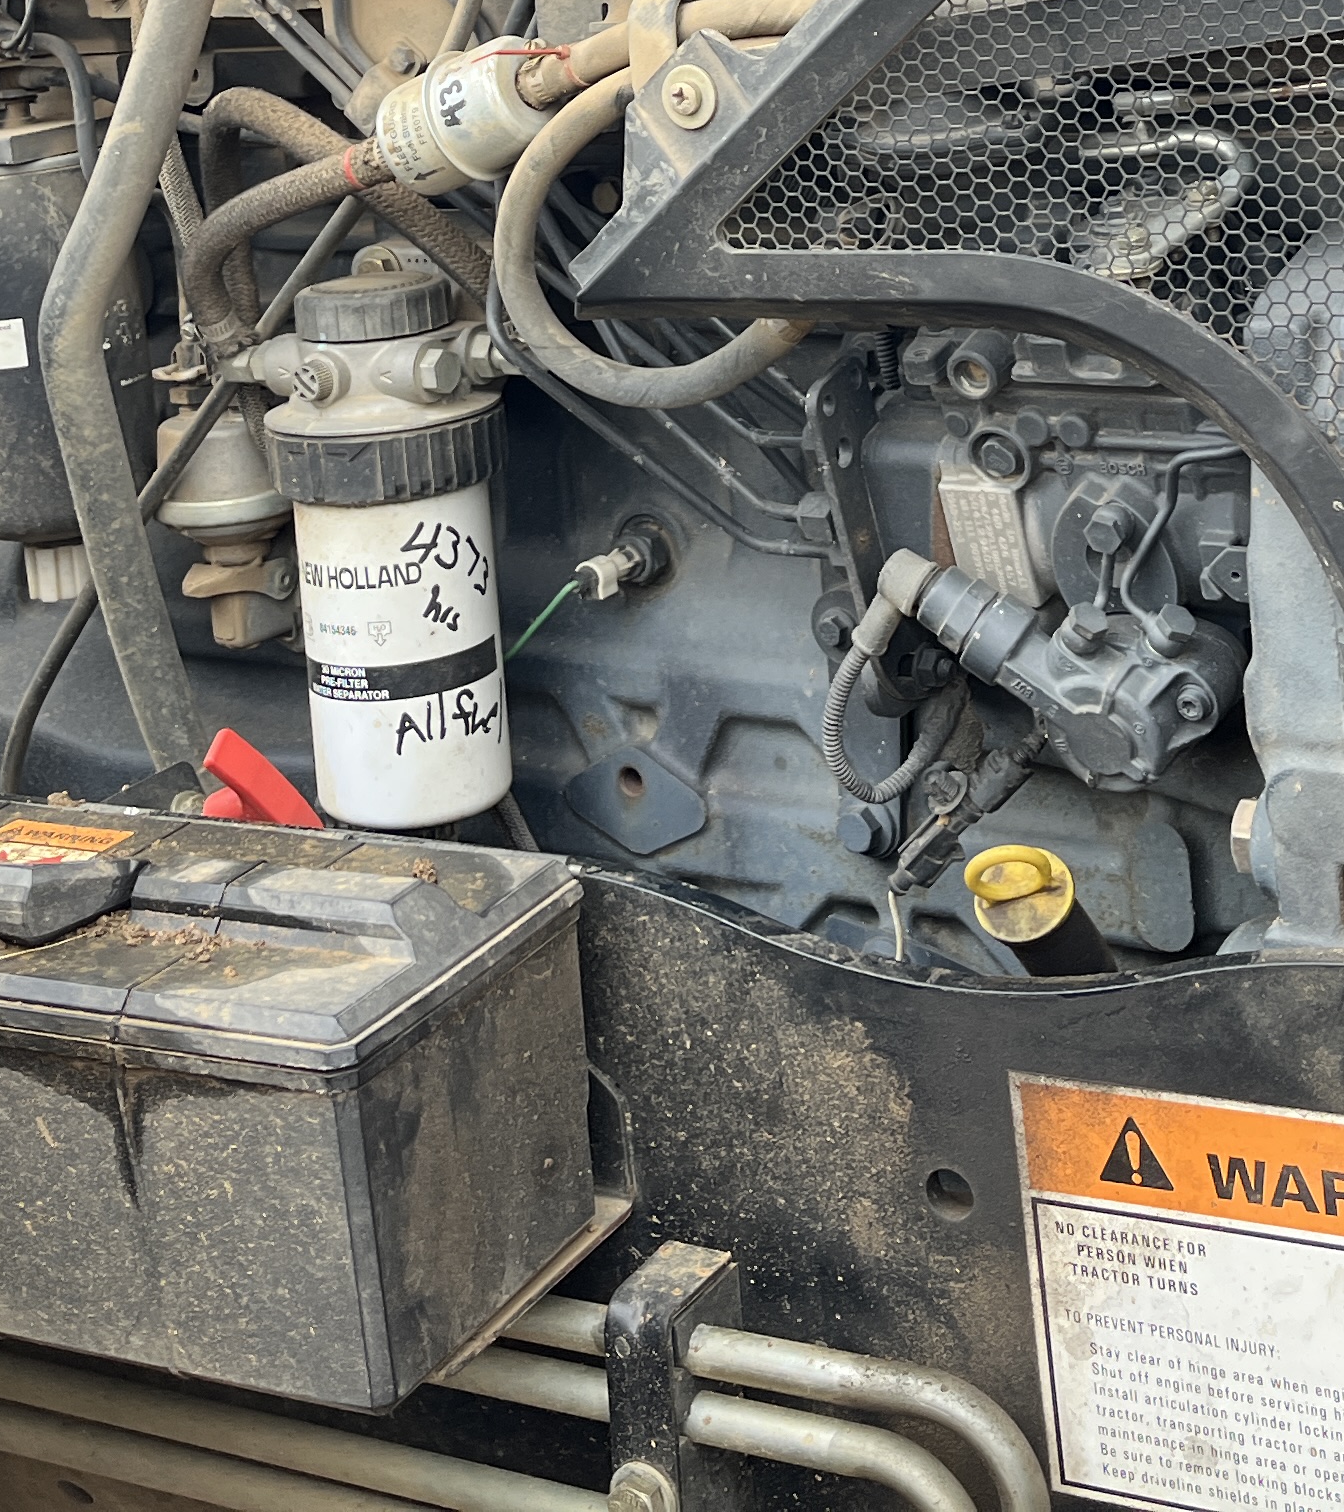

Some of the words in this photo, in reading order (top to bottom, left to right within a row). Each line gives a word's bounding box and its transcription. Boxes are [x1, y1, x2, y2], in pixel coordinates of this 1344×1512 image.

[1099, 461, 1146, 476] BOSCH
[327, 562, 422, 590] HOLLAND
[320, 675, 369, 689] PRE-FILTER
[330, 666, 366, 678] MICRON
[333, 688, 390, 701] SEPARATOR
[395, 692, 446, 755] All
[25, 829, 114, 845] WARNING
[1055, 1220, 1075, 1237] NO
[1082, 1225, 1170, 1252] CLEARANCE
[1178, 1240, 1207, 1258] FOR
[1077, 1243, 1137, 1266] PERSON
[1144, 1255, 1189, 1274] WHEN
[1070, 1262, 1141, 1286] TRACTOR
[1148, 1275, 1199, 1297] TURNS
[1065, 1309, 1082, 1324] TO
[1086, 1312, 1145, 1336] PREVENT
[1150, 1323, 1222, 1350] PERSONAL
[1226, 1337, 1281, 1360] INJURY:
[1089, 1342, 1120, 1362] Stay
[1127, 1350, 1161, 1367] clear
[1168, 1356, 1181, 1370] of
[1188, 1360, 1226, 1380] hinge
[1233, 1370, 1264, 1386] area
[1271, 1375, 1308, 1395] when
[1091, 1362, 1123, 1381] Shut
[1129, 1370, 1149, 1385] off
[1156, 1375, 1202, 1395] engine
[1208, 1383, 1254, 1405] before
[1260, 1395, 1328, 1421] servicing
[1093, 1383, 1138, 1404] Install
[1144, 1393, 1229, 1420] articulation
[1234, 1409, 1292, 1433] cylinder
[1096, 1403, 1151, 1426] tractor,
[1156, 1415, 1246, 1446] transporting
[1252, 1433, 1303, 1456] tractor
[1310, 1446, 1327, 1460] on
[1098, 1425, 1186, 1453] maintenance
[1192, 1441, 1204, 1455] in
[1211, 1445, 1249, 1465] hinge
[1255, 1454, 1287, 1472] area
[1293, 1463, 1307, 1476] or
[1100, 1442, 1117, 1458] Be
[1123, 1448, 1153, 1465] sure
[1159, 1456, 1173, 1469] to
[1178, 1460, 1229, 1481] remove
[1294, 1481, 1342, 1503] blocks
[1103, 1463, 1135, 1483] Keep
[1141, 1471, 1203, 1495] driveline
[1208, 1486, 1258, 1507] shields
[1264, 1494, 1278, 1511] in
